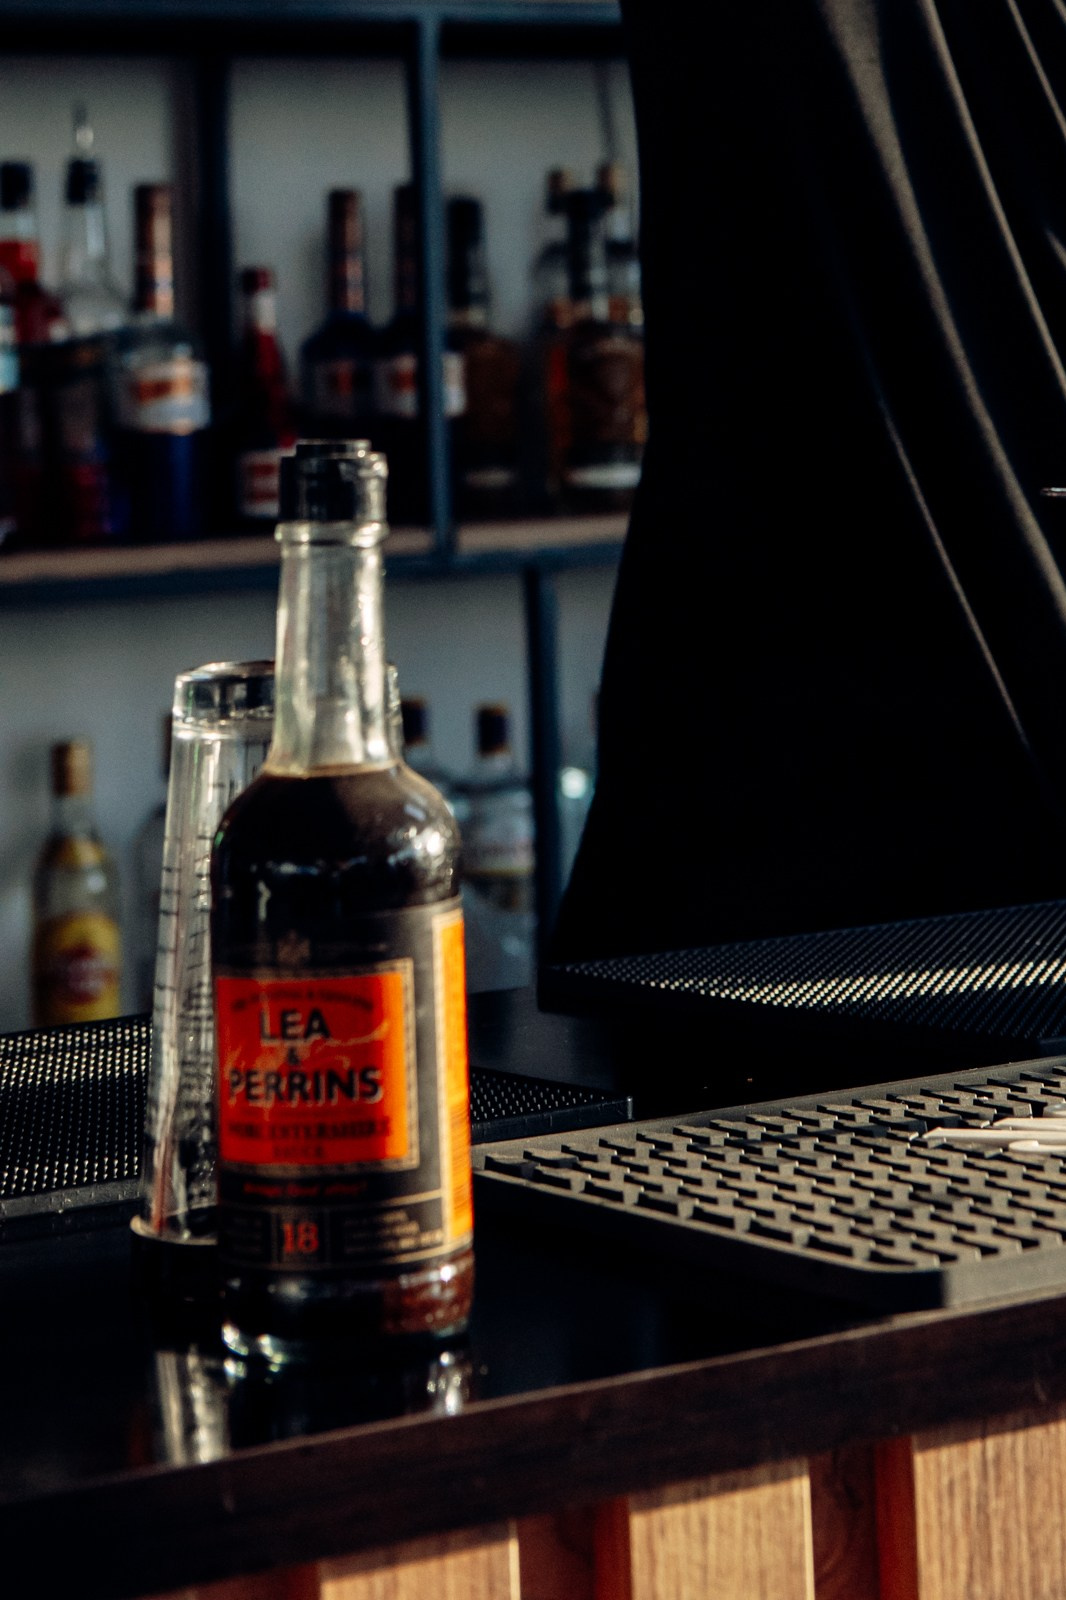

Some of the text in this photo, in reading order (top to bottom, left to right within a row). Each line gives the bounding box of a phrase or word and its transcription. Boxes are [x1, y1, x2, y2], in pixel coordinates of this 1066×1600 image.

[259, 1007, 332, 1041] LEA
[229, 1066, 381, 1102] PERRINS
[281, 1221, 319, 1254] 18
